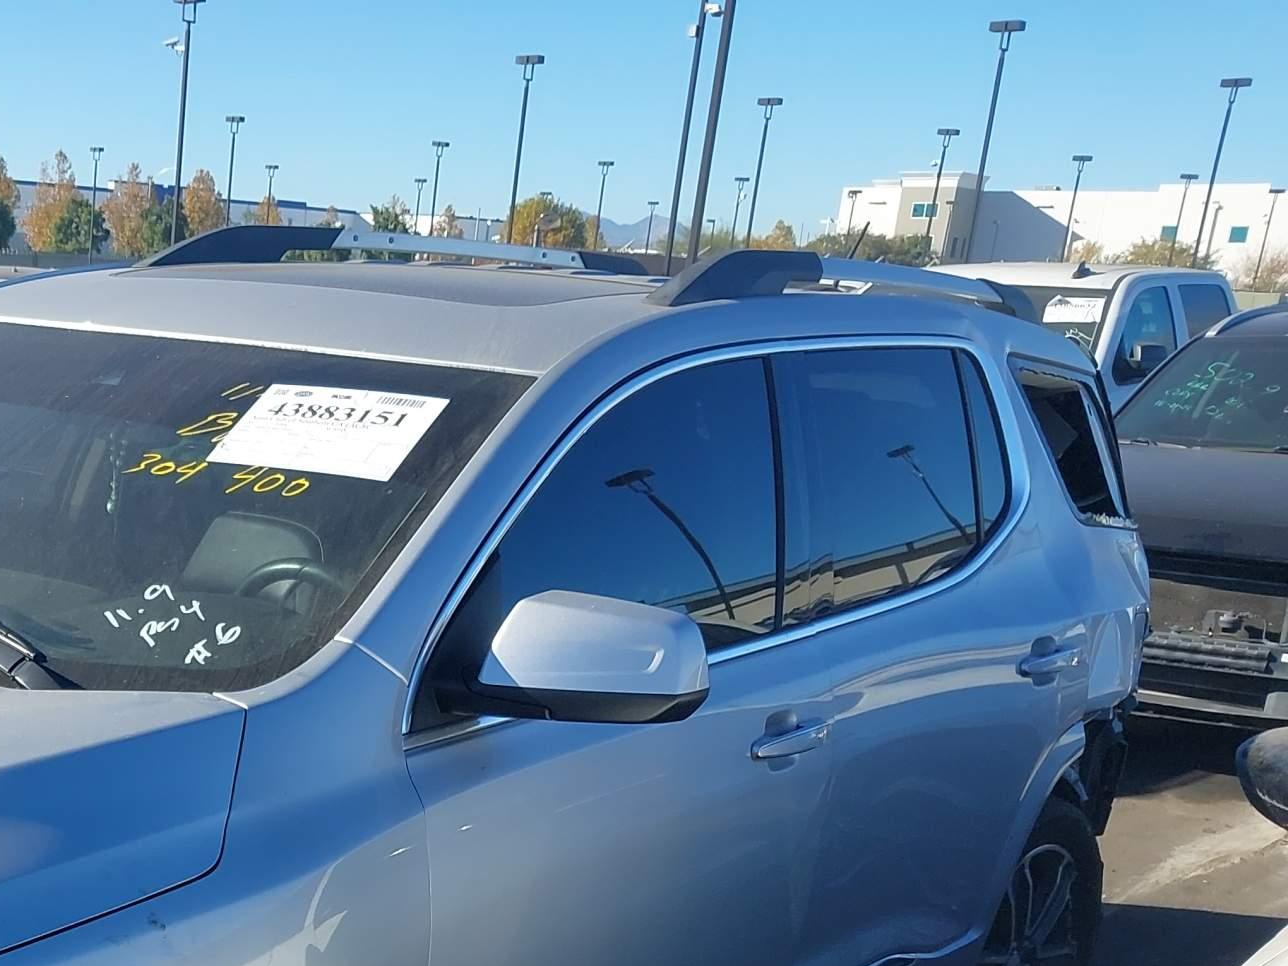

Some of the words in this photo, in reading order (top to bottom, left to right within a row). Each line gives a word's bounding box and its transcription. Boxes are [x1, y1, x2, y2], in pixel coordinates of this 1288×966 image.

[267, 402, 408, 427] 43883151
[121, 453, 209, 484] 304
[224, 465, 310, 497] 400
